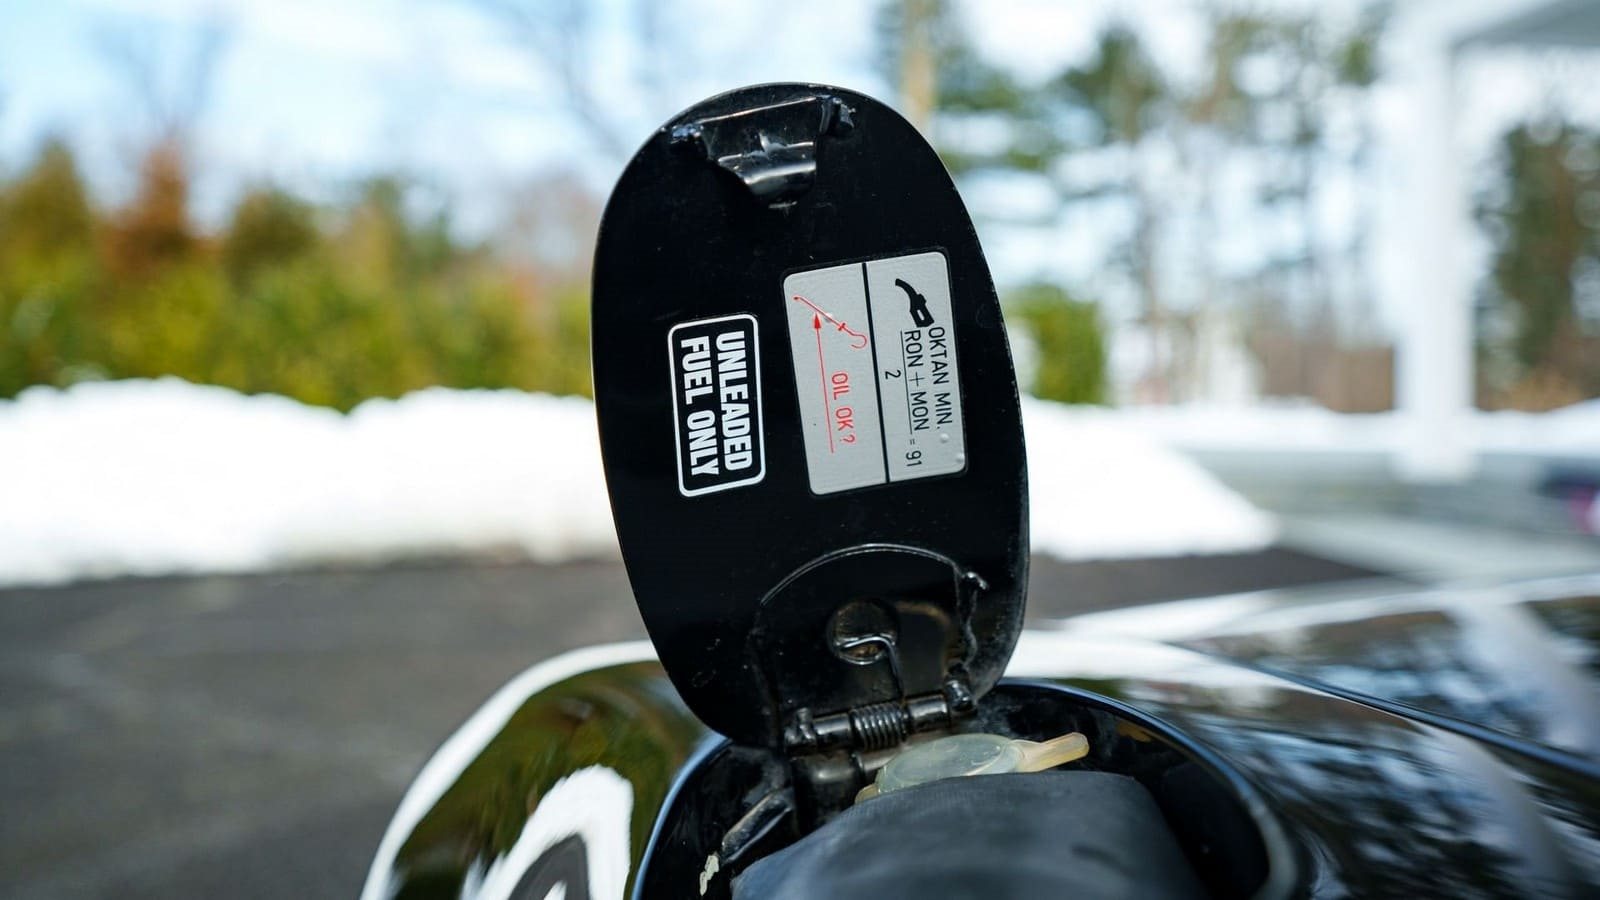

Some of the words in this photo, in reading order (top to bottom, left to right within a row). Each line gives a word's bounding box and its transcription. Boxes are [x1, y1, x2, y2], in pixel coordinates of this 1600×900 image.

[904, 330, 924, 368] RON
[928, 326, 950, 385] OKTAN
[680, 335, 714, 405] FUEL
[831, 372, 849, 400] OIL
[885, 369, 901, 379] 2
[716, 330, 753, 471] UNLEADED
[910, 391, 930, 431] MON
[934, 392, 953, 430] MIN.
[687, 409, 720, 476] ONLY
[905, 450, 922, 467] 91
